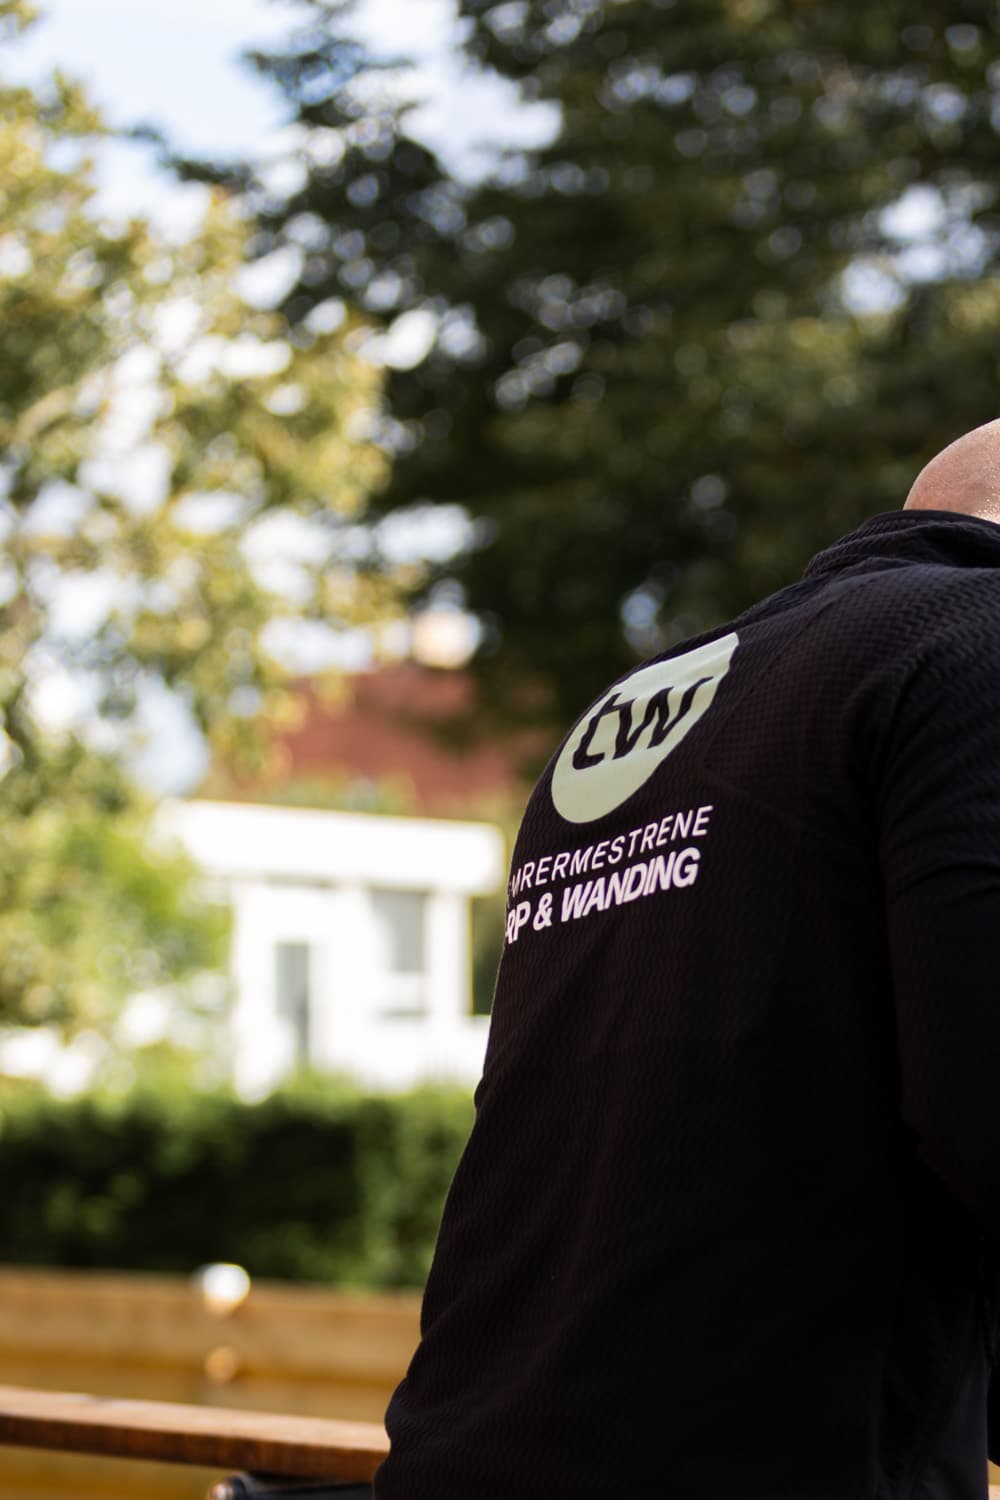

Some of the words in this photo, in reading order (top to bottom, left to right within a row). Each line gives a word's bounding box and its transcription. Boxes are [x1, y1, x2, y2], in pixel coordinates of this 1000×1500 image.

[505, 901, 531, 944] RP
[533, 892, 553, 931] &
[561, 847, 701, 922] WANDING
[508, 806, 713, 898] MRERMESTRENE
